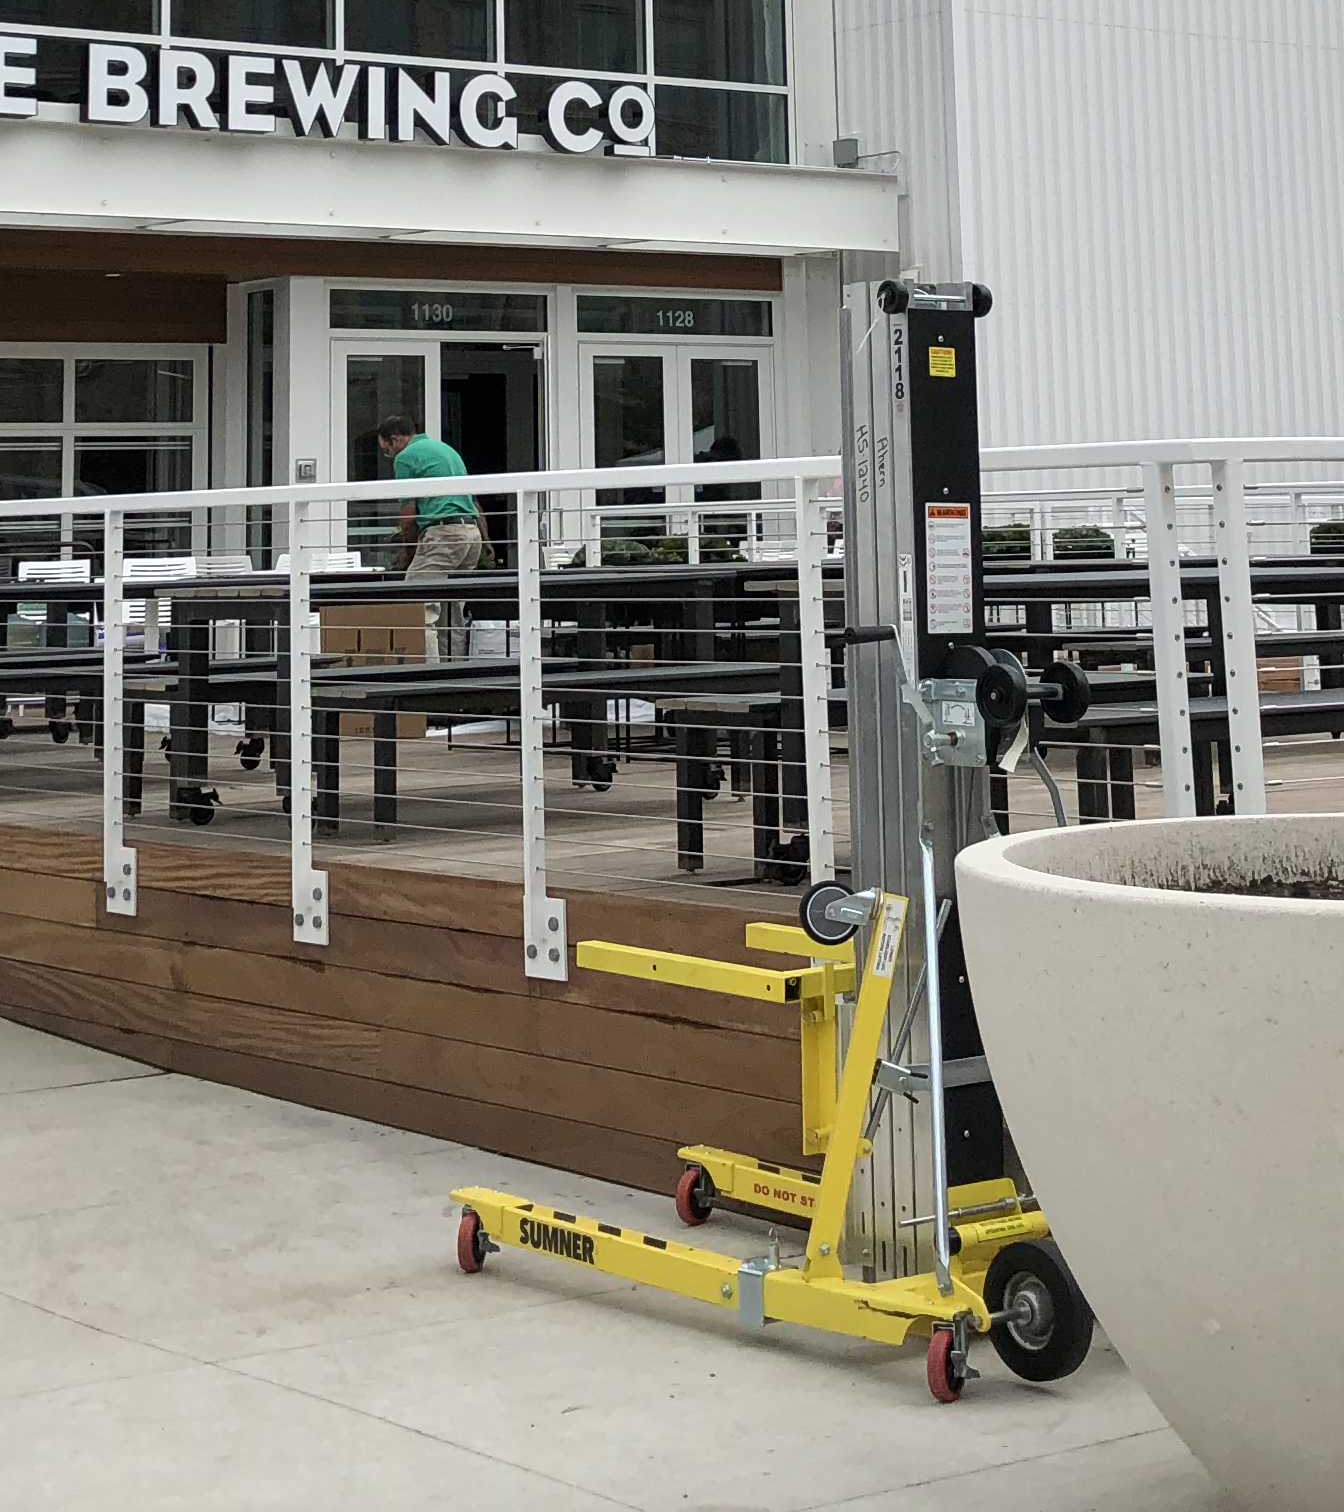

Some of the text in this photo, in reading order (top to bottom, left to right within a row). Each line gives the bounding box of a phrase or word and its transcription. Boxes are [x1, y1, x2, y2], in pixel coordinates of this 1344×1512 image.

[84, 42, 519, 150] BREWING
[546, 80, 656, 156] CO
[411, 303, 453, 322] 1130
[656, 310, 695, 328] 1128
[753, 1183, 816, 1207] DO NOT ST
[519, 1217, 595, 1265] SUMNER
